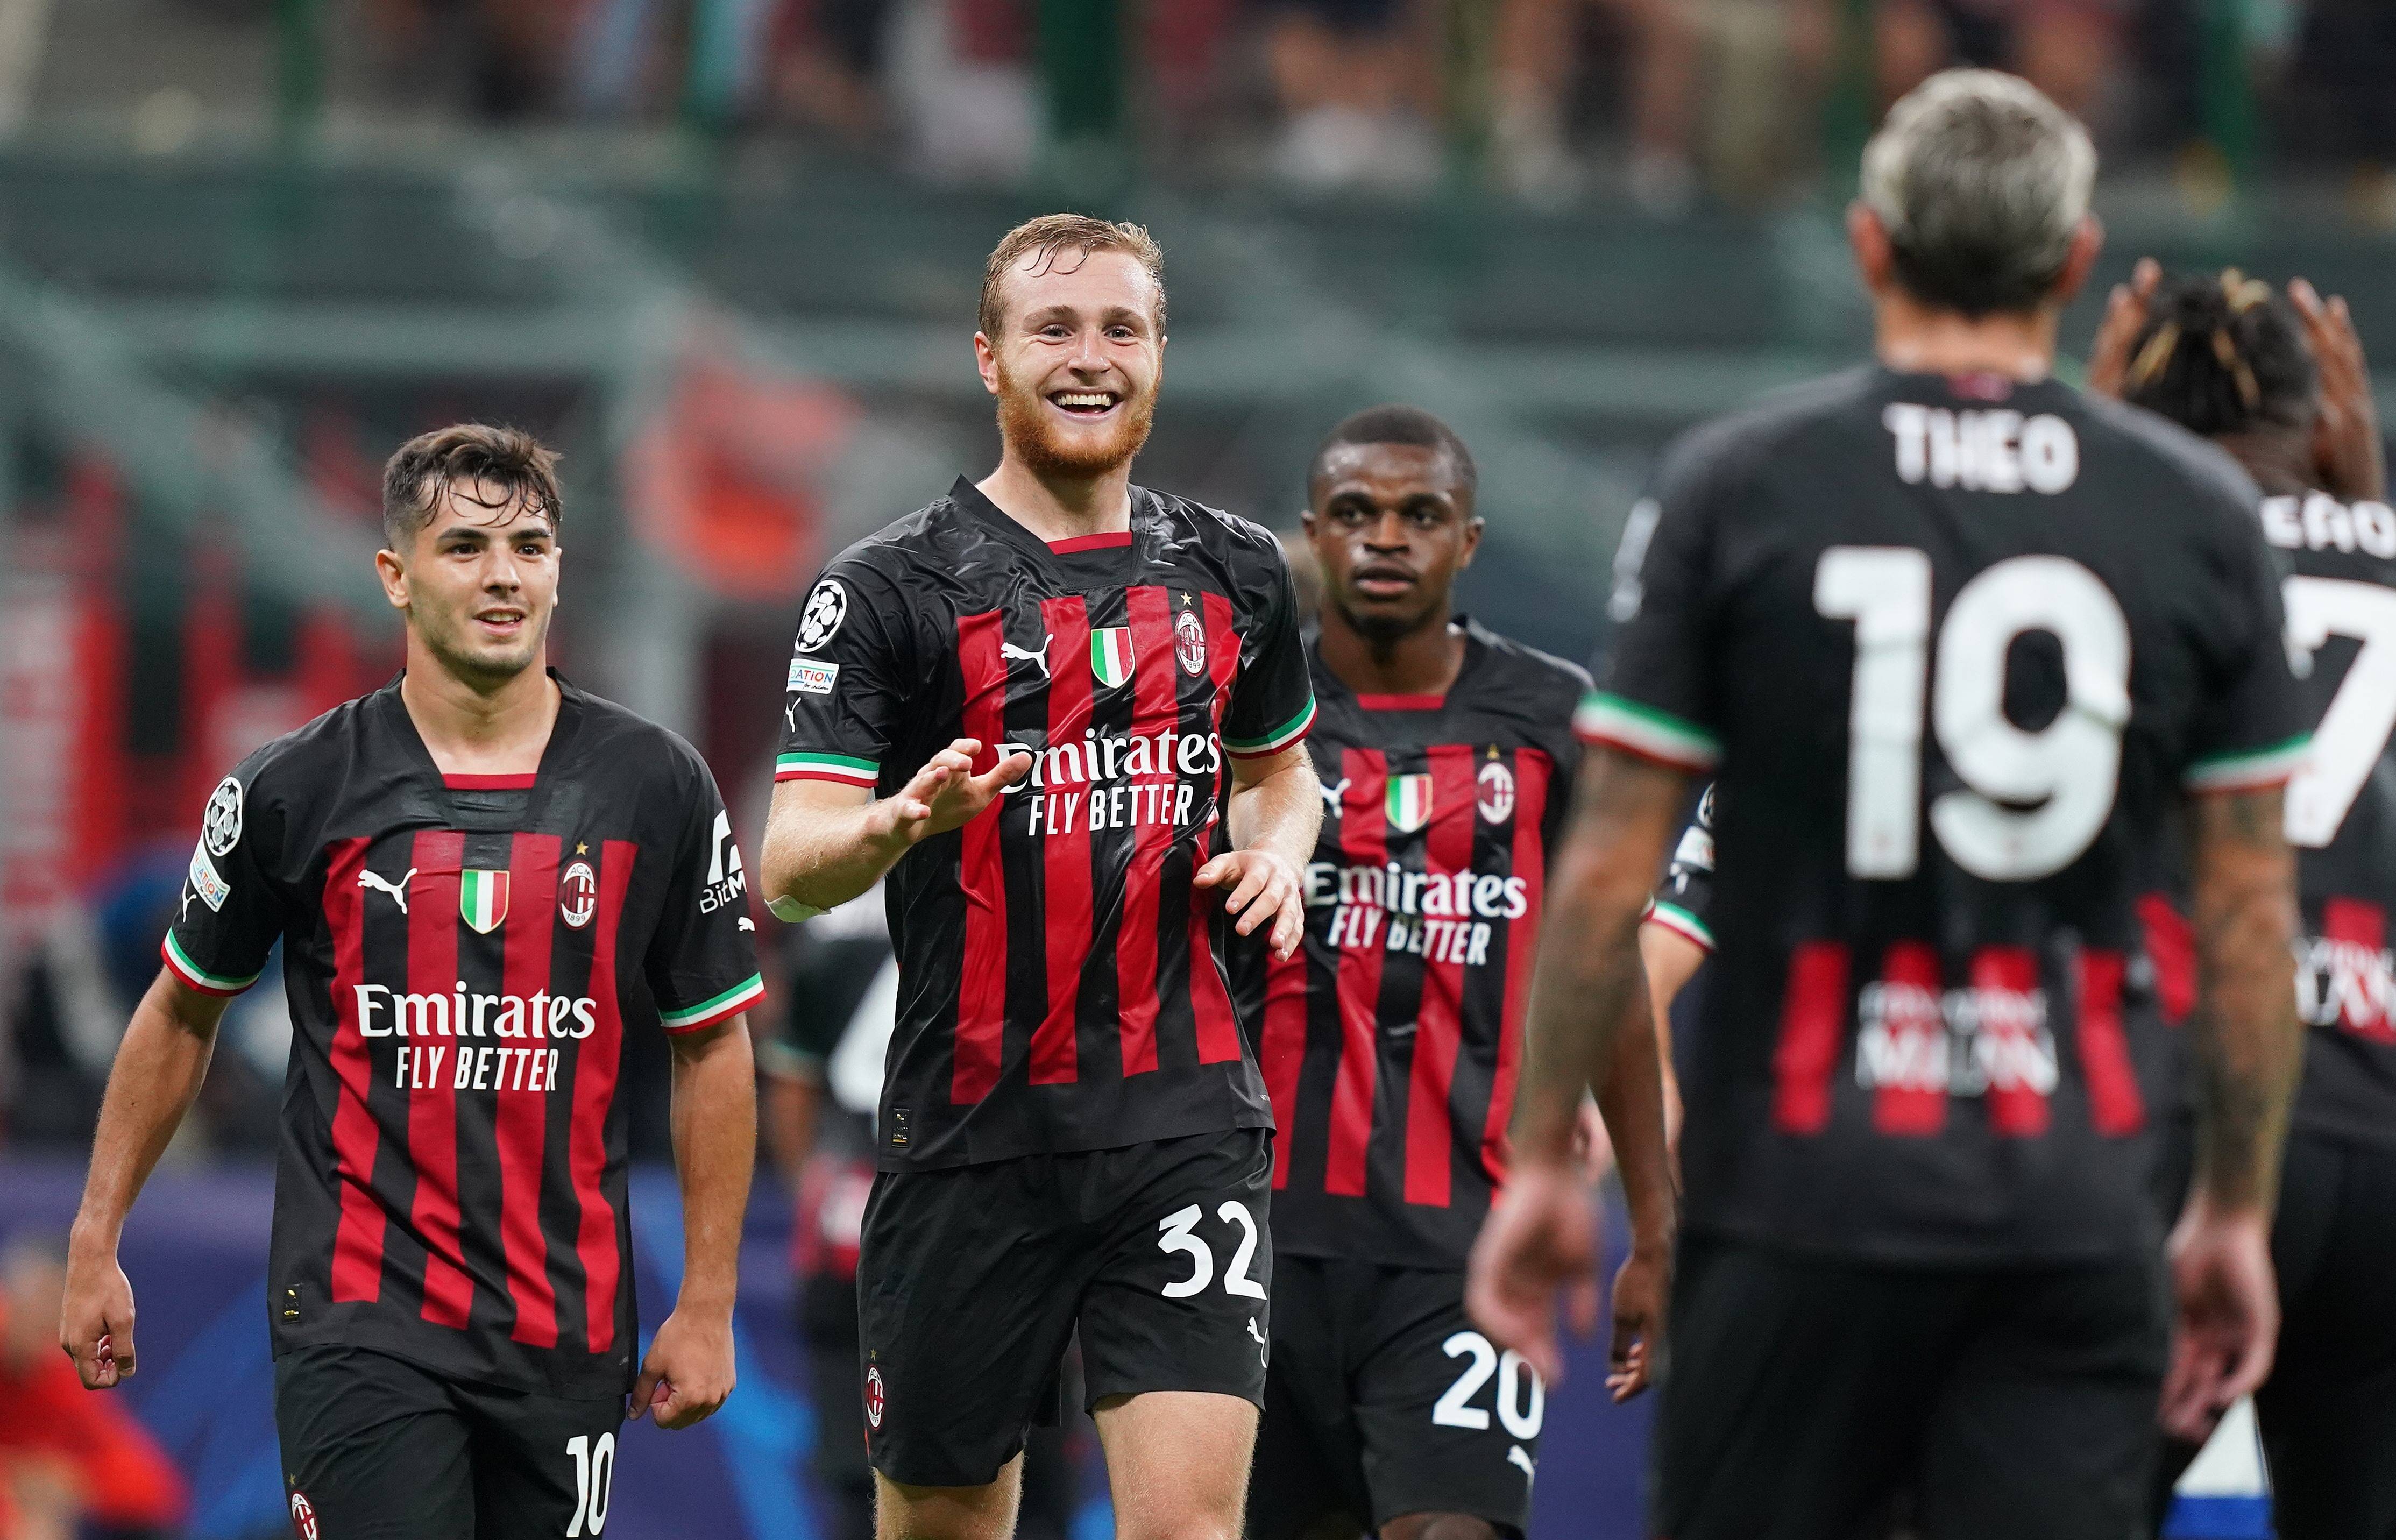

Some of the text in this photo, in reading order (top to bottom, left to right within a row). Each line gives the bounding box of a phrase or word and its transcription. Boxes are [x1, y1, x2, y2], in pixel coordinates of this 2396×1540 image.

[1882, 402, 2080, 494] THEO
[1181, 615, 1199, 628] ACM
[1186, 661, 1201, 669] 1899
[1813, 546, 2132, 881] 19
[1029, 784, 1194, 836] FLY BETTER
[569, 865, 591, 879] ACM
[1303, 862, 1527, 919] Emirates
[566, 913, 586, 921] 1899
[1327, 905, 1492, 966] FLY BETTER
[353, 981, 597, 1038] Emirates
[396, 1046, 559, 1091] FLY BETTER
[1158, 1201, 1267, 1300] 32
[1432, 1331, 1546, 1440] 20
[566, 1432, 615, 1537] 10
